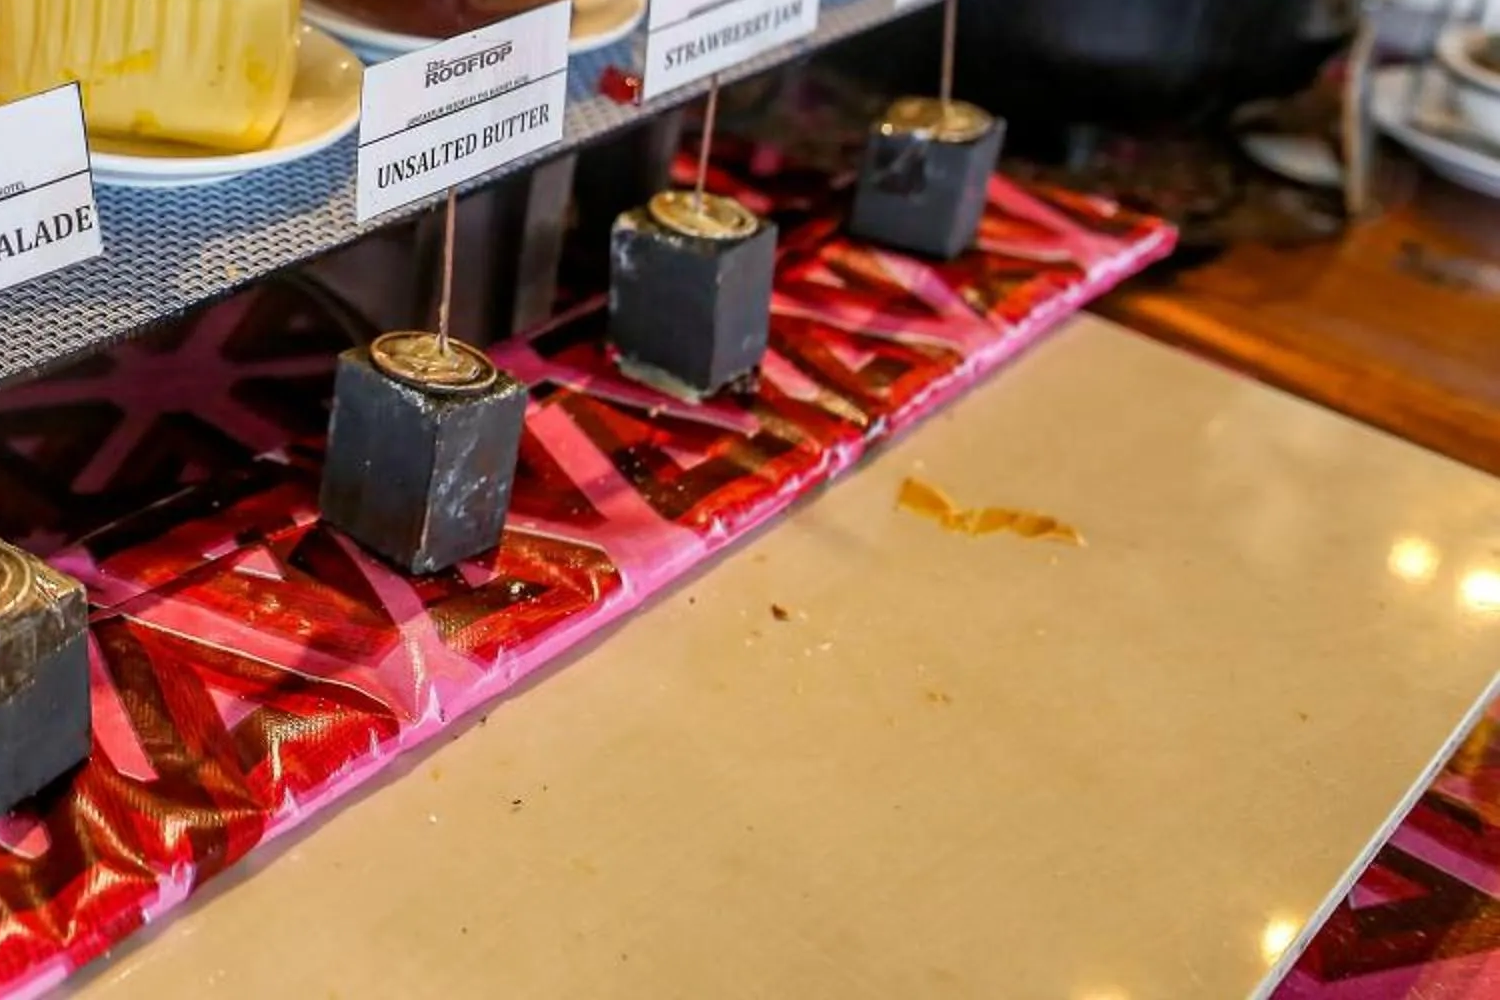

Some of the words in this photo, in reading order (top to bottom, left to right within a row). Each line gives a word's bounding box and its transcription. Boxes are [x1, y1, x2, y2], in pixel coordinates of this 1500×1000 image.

[425, 45, 514, 88] ROOFTOP
[663, 8, 772, 70] STRAWBERRY
[376, 132, 477, 189] UNSALTED
[482, 103, 549, 149] BUTTER
